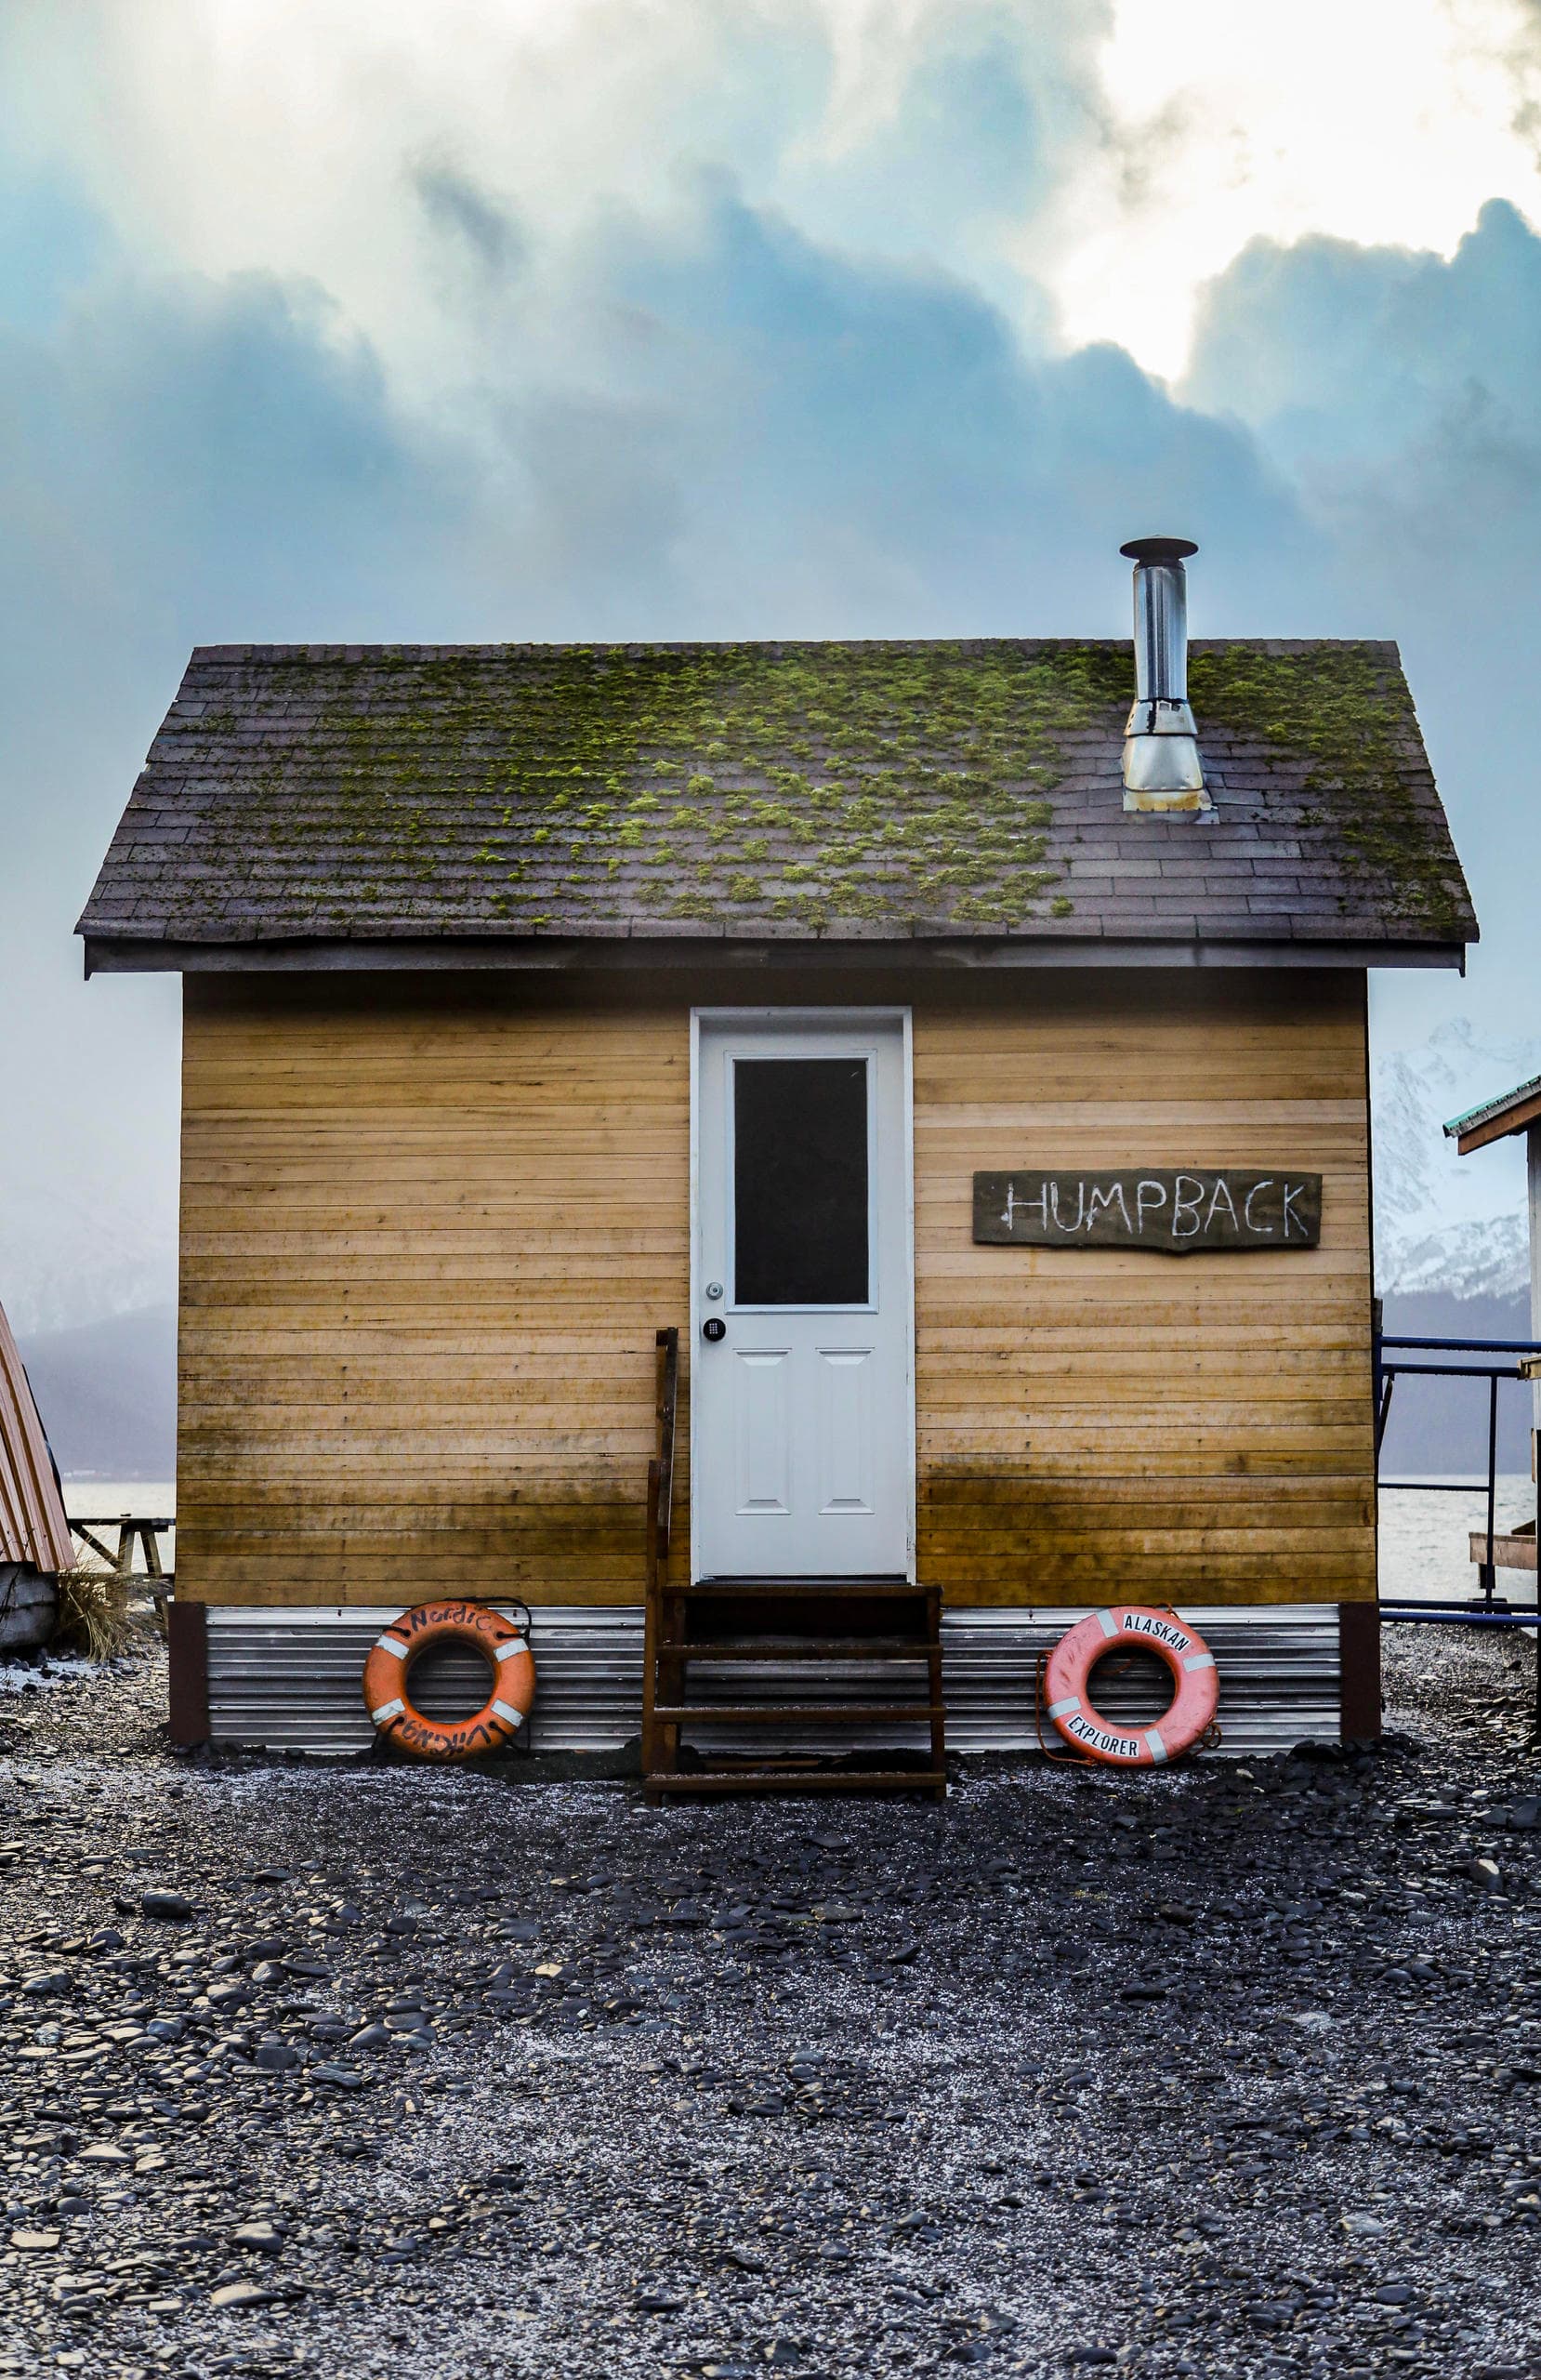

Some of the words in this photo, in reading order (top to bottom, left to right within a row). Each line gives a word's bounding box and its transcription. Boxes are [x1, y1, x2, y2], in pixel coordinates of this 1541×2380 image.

[1001, 1175, 1309, 1237] HUMPBACK
[410, 1606, 492, 1632] Nordic
[1125, 1615, 1189, 1652] ALASKAN
[1068, 1716, 1138, 1756] EXPLORER
